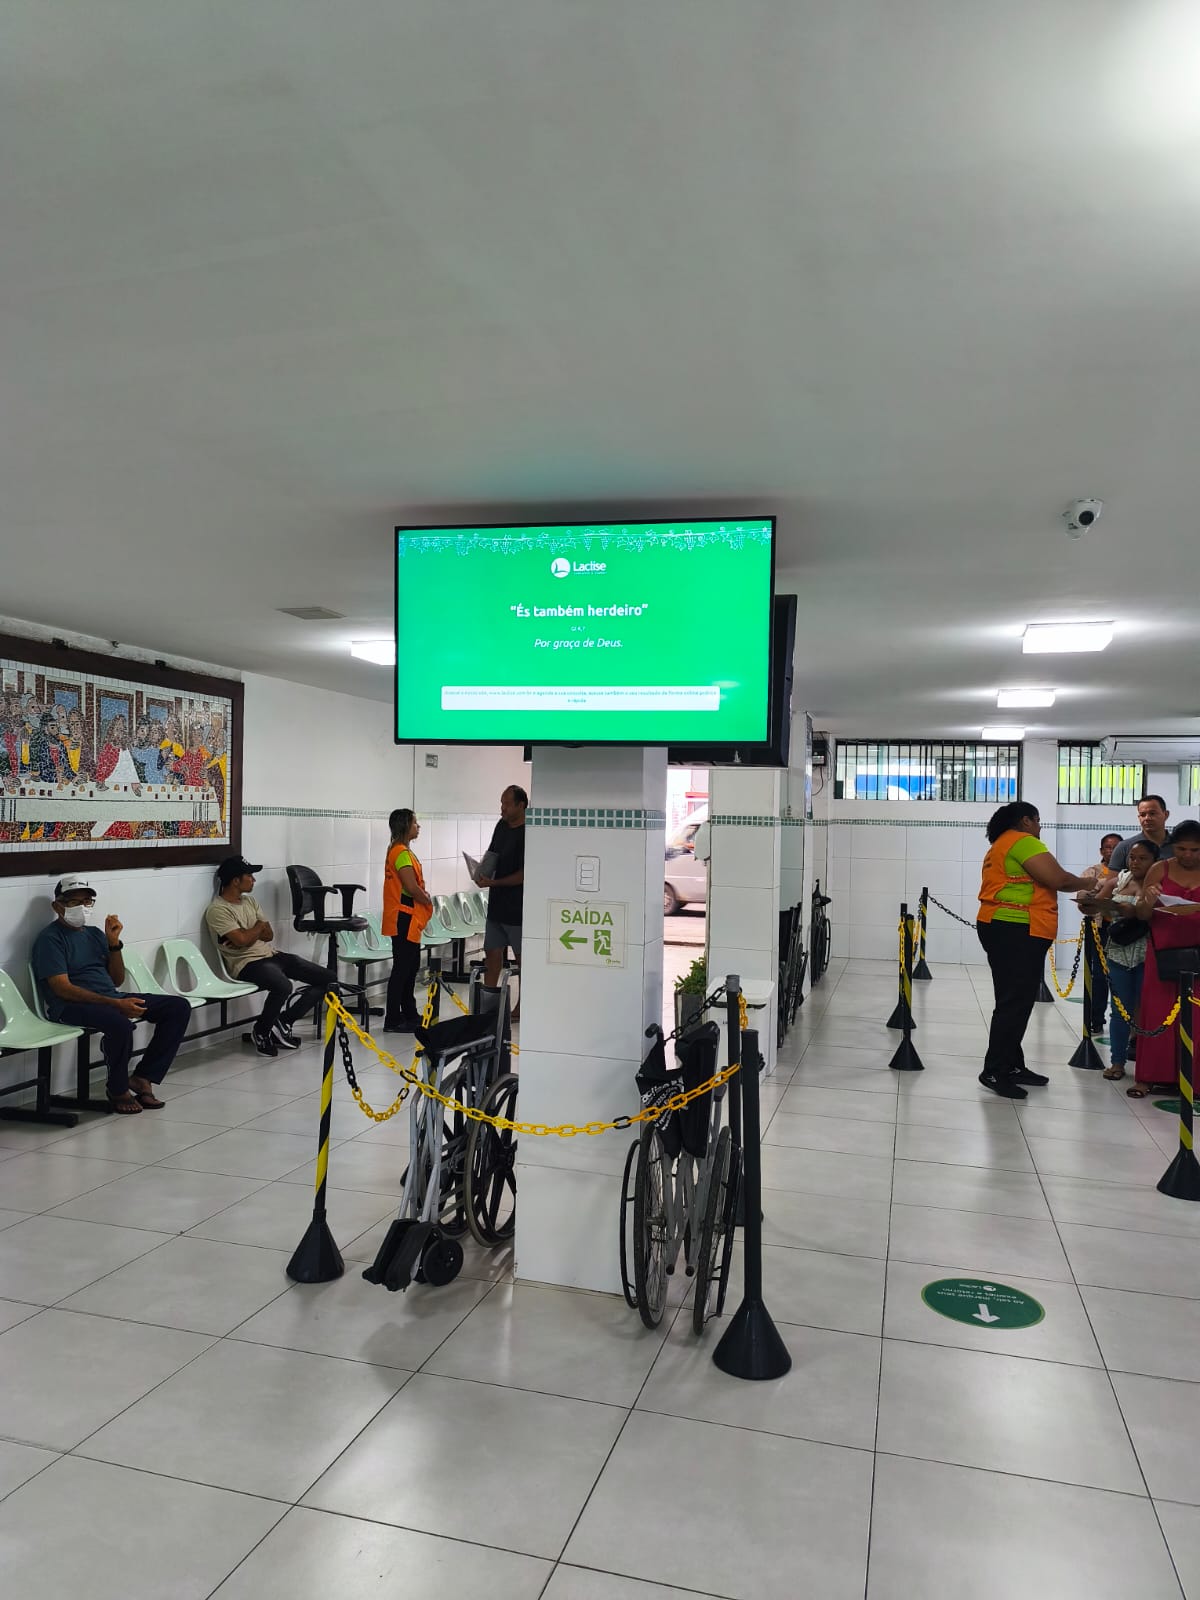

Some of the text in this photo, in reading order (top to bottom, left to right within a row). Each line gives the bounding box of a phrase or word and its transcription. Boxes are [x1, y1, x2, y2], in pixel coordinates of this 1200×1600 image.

[572, 560, 607, 572] Lactise
[533, 604, 584, 617] também
[534, 637, 624, 650] Por graça de Deus.
[561, 906, 614, 926] SAÍDA
